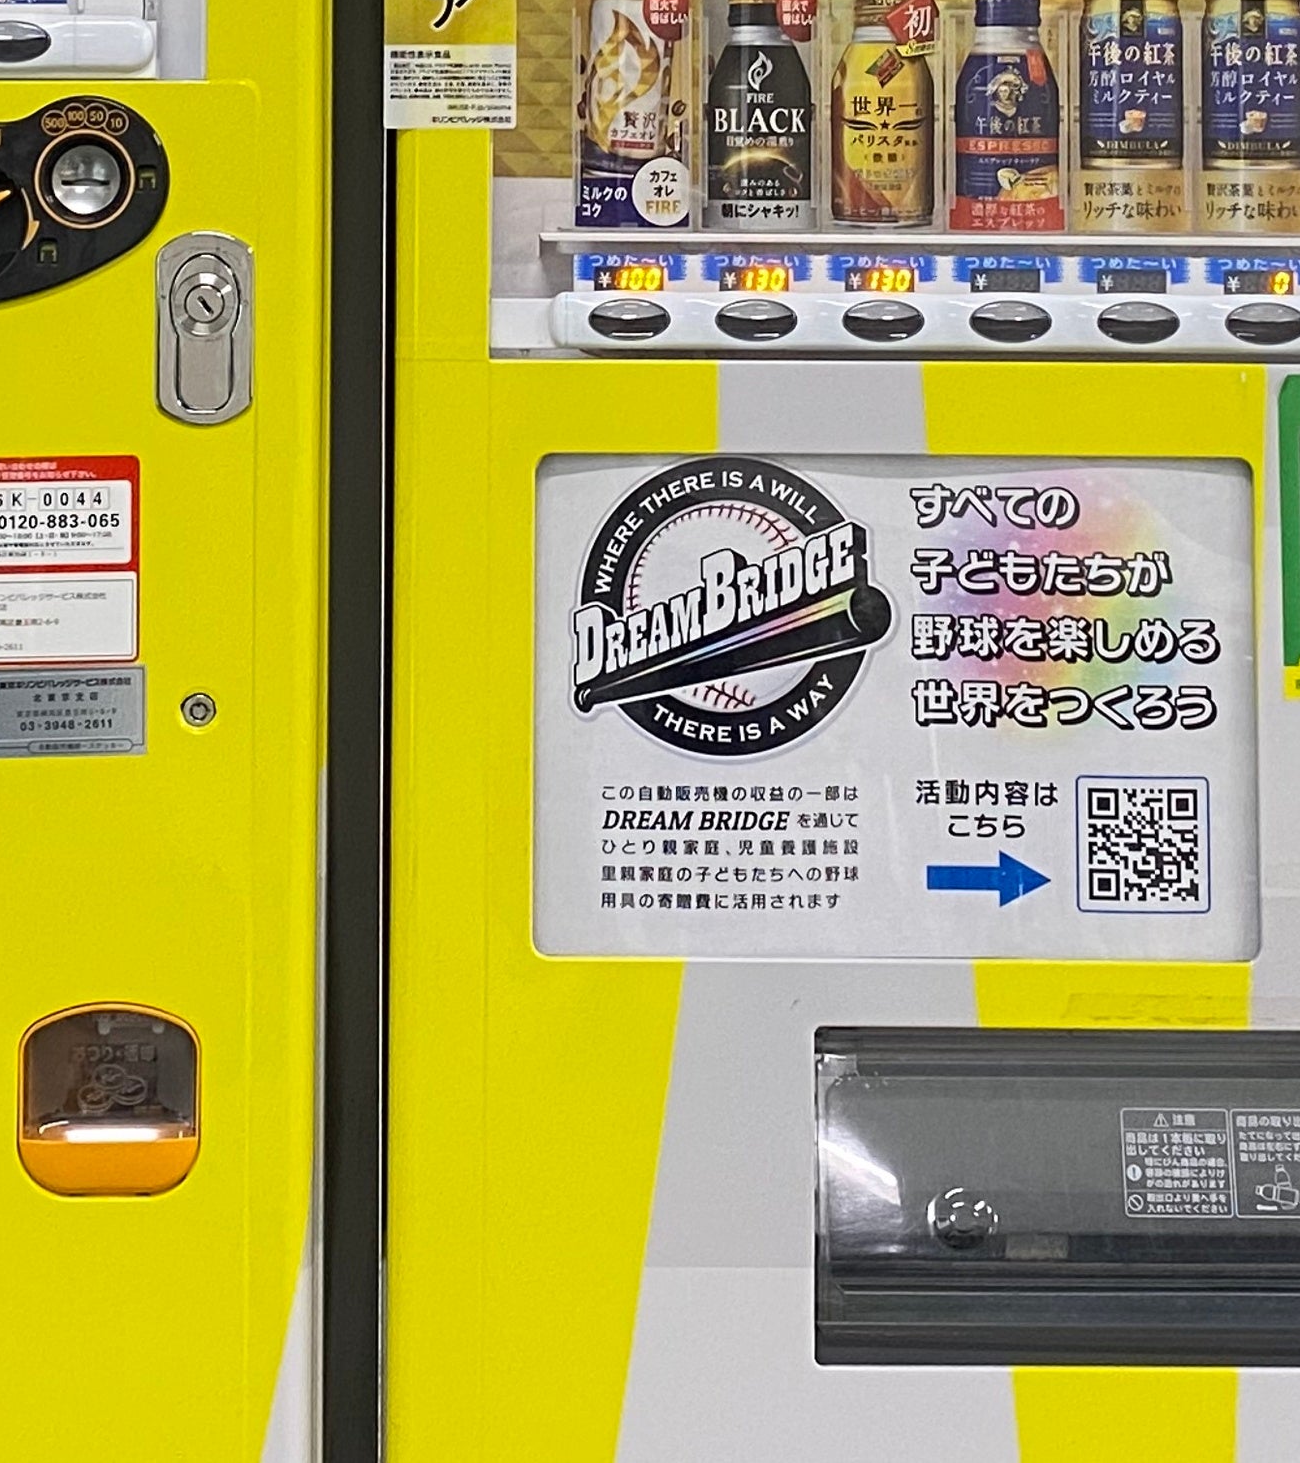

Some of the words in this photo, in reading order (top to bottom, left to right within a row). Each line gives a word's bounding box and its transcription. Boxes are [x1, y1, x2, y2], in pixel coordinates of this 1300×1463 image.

[903, 4, 932, 39] 初
[1087, 43, 1175, 66] 午後の紅茶
[746, 93, 774, 104] FIRE
[67, 109, 84, 123] 100
[89, 110, 104, 123] 50
[109, 117, 123, 129] 10
[714, 107, 805, 134] BLACK
[582, 185, 627, 203] ミルクの
[910, 485, 1078, 527] すべての
[912, 550, 1172, 595] 子どもたちが
[912, 616, 1221, 662] 野球を楽しめる
[912, 681, 1220, 729] 世界をつくろう
[602, 786, 859, 801] この自動販売機の収益の一部は
[916, 780, 1058, 806] 活動内容は
[603, 810, 694, 830] DREAM
[698, 810, 790, 830] BRIDGE
[797, 813, 859, 827] を通じて
[948, 814, 1025, 838] こちら
[602, 866, 859, 882] 里親家庭の子どもたちへの野球
